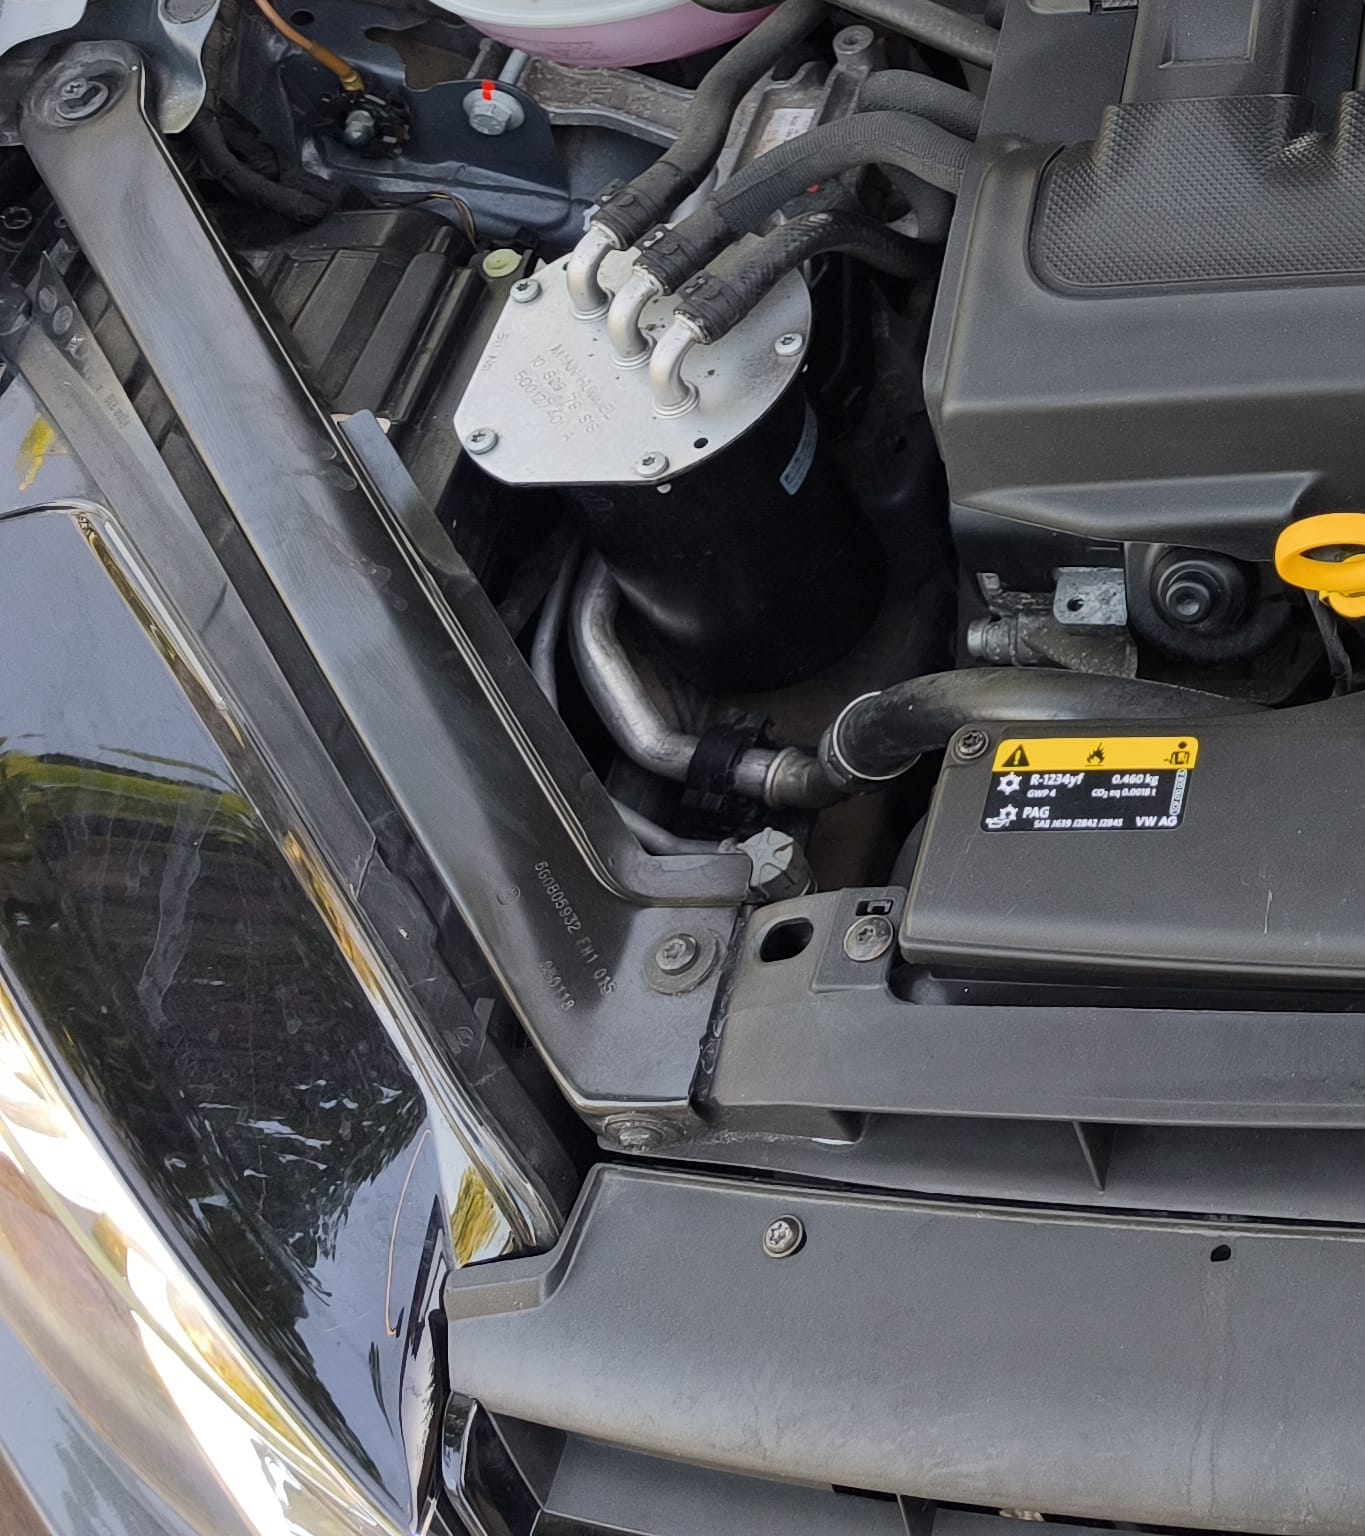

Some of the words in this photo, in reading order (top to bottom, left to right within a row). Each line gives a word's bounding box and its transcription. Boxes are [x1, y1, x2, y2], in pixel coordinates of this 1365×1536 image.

[1029, 773, 1086, 787] R-1234yf
[1111, 774, 1143, 785] 0.460
[1145, 774, 1159, 787] kg
[1026, 788, 1050, 798] GWP
[1022, 806, 1050, 819] PAG
[1135, 816, 1157, 827] VW
[1158, 816, 1178, 827] AG
